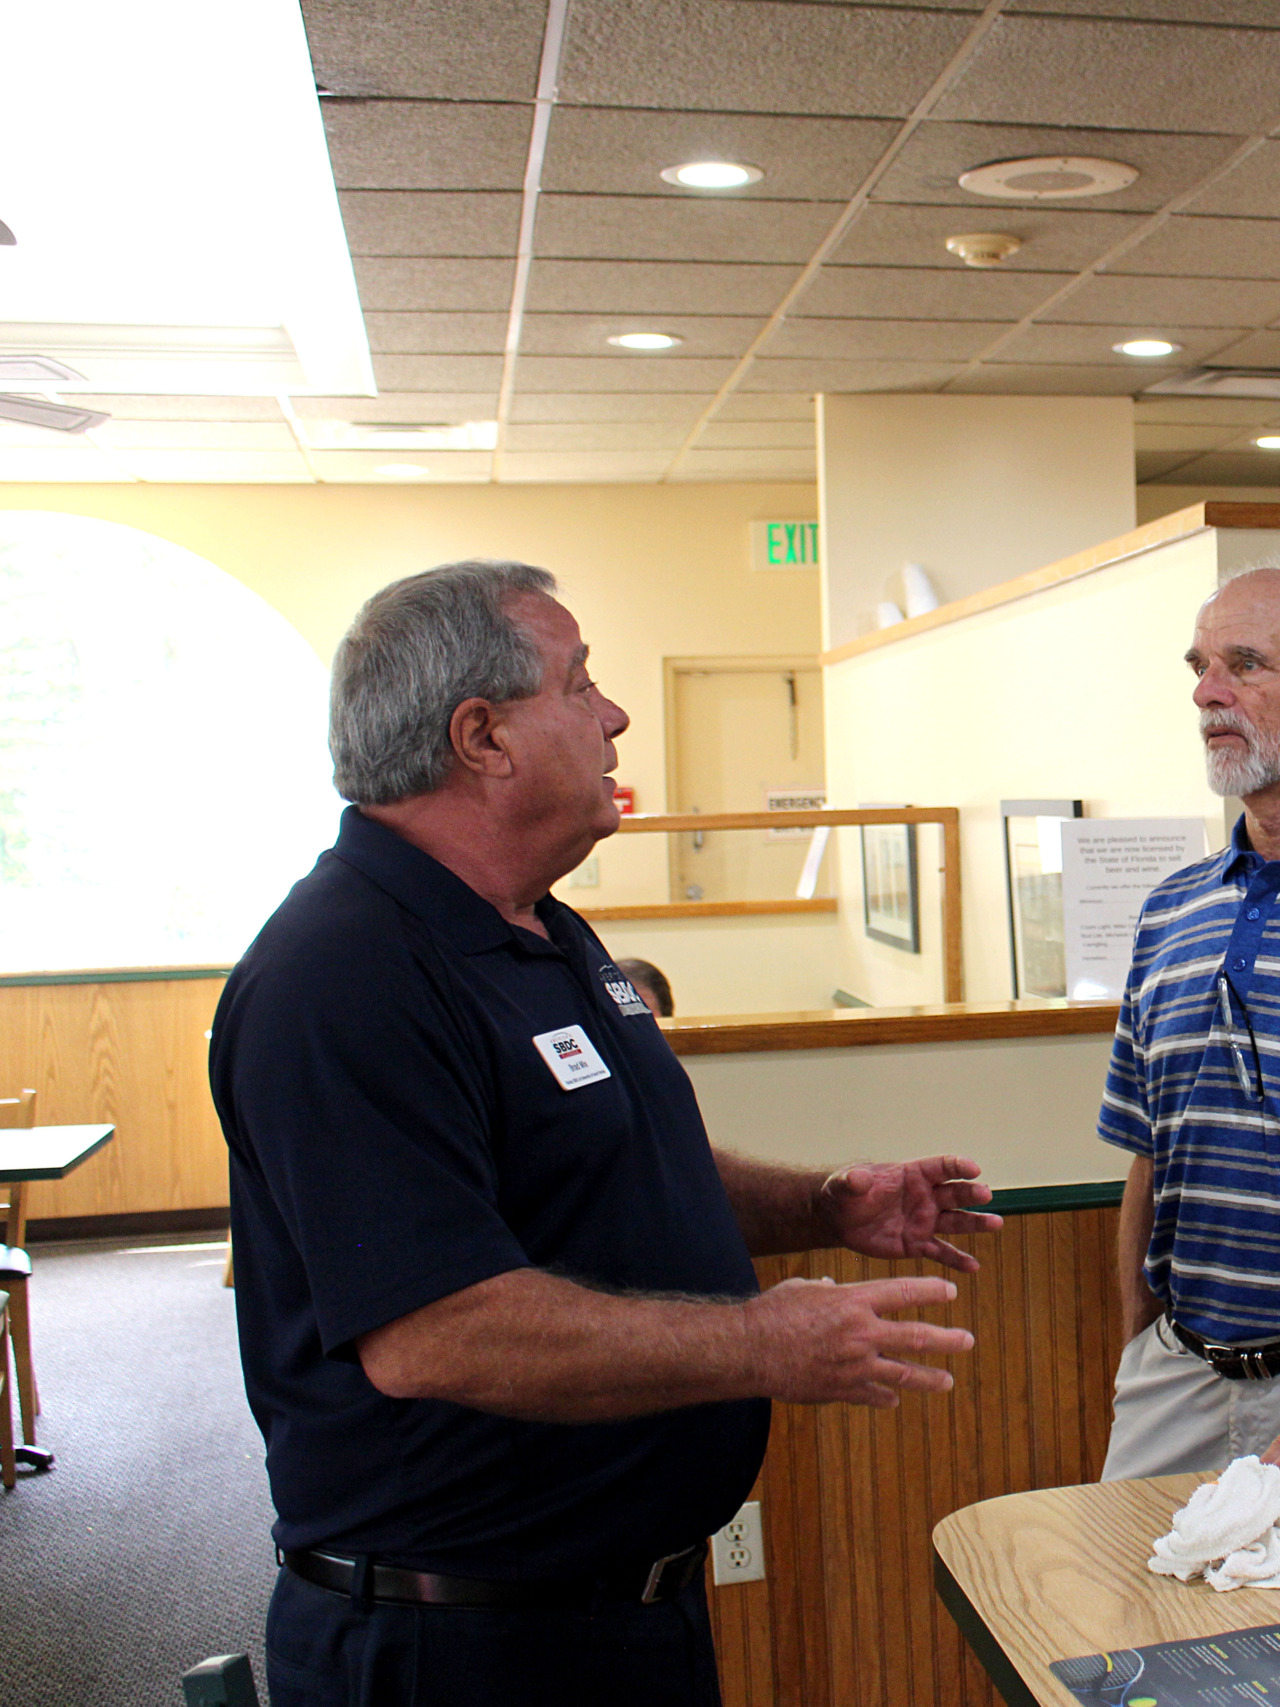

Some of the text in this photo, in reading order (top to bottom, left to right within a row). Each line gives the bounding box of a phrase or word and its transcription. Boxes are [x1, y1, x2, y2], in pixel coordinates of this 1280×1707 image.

[767, 523, 819, 564] EXIT
[1175, 845, 1185, 853] by
[552, 1038, 579, 1054] SBDC
